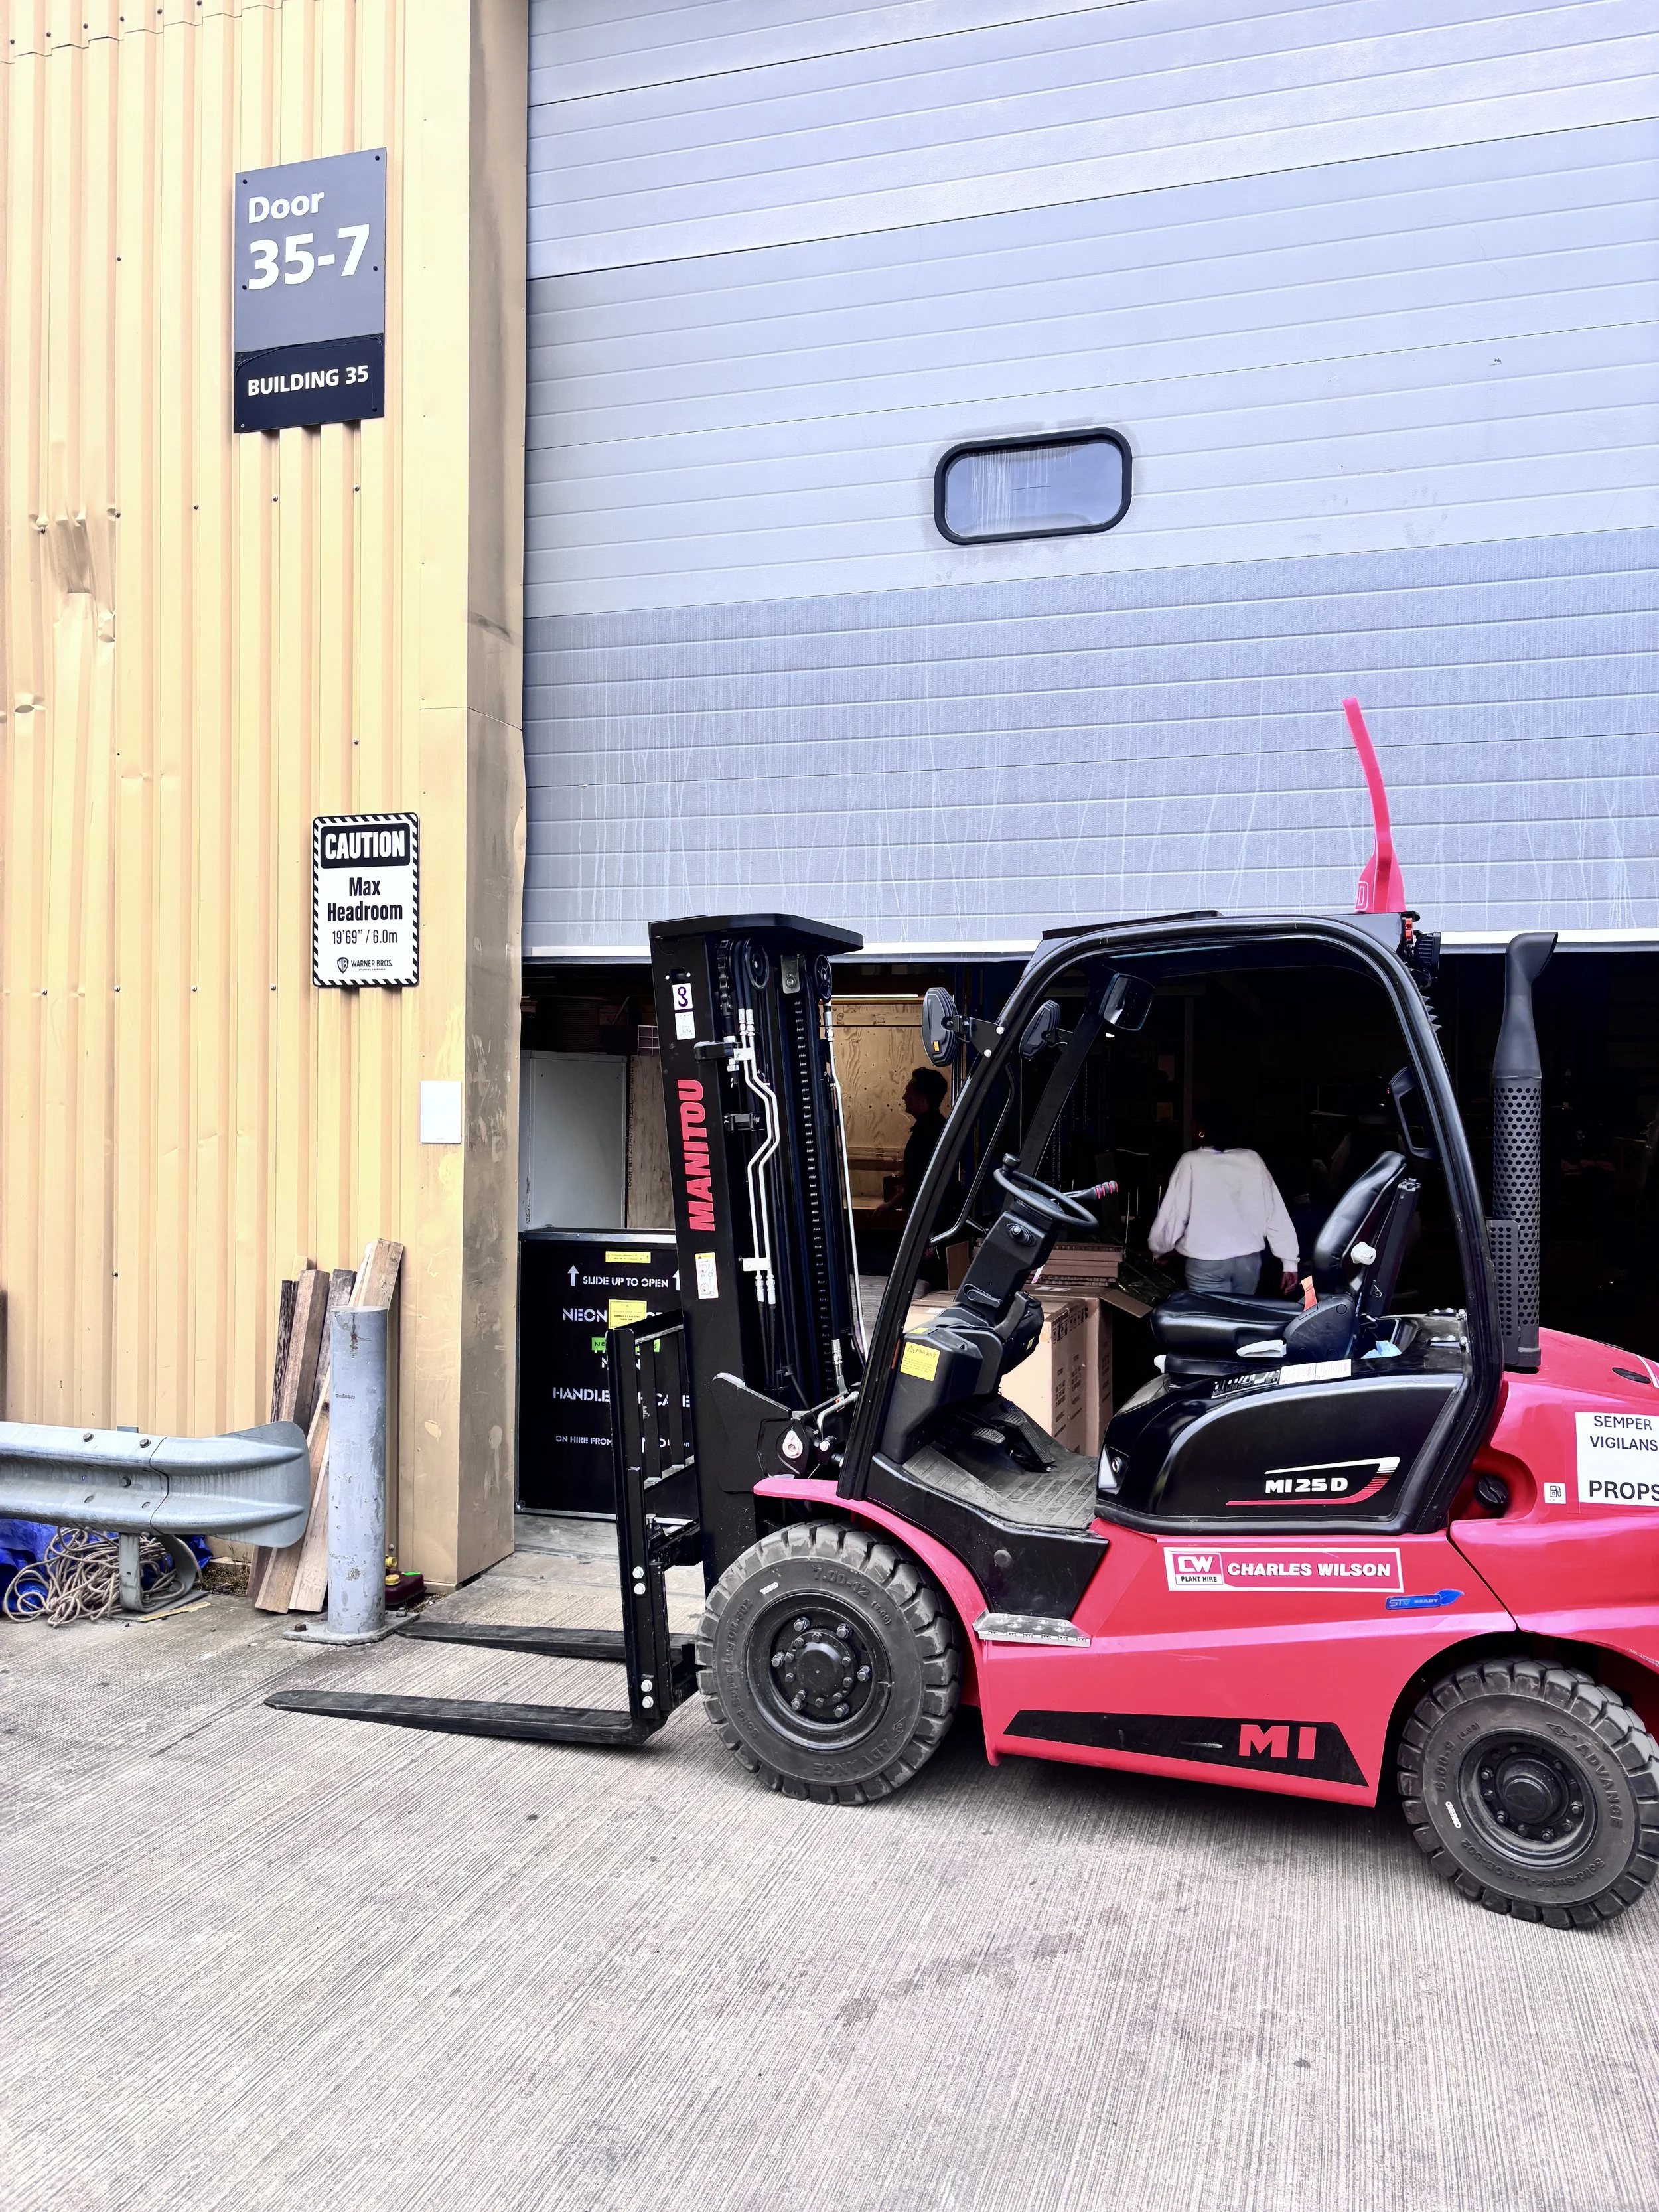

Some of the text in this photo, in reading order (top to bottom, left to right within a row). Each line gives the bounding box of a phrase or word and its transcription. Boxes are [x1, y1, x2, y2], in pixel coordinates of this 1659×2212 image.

[248, 192, 325, 224] Door
[248, 224, 370, 290] 35-7
[248, 364, 369, 396] BUILDING 35
[325, 830, 405, 860] CAUTION
[349, 877, 381, 897] Max
[327, 900, 403, 922] Headroom
[373, 929, 397, 944] 6.0m
[350, 959, 375, 968] WARNER
[376, 959, 394, 968] BROS.
[677, 1079, 715, 1232] MANITOU
[583, 1276, 669, 1288] SLIDE UP TO OPEN
[563, 1308, 607, 1323] NEON
[1593, 1415, 1652, 1430] SEMPER
[570, 1436, 589, 1444] HIRE
[1589, 1436, 1658, 1451] VIGILANS
[1589, 1480, 1659, 1501] PROPS
[1177, 1556, 1213, 1572] CW
[1227, 1562, 1391, 1577] CHARLES WILSON
[812, 1565, 870, 1599] 7.00-12
[1238, 1724, 1317, 1760] MI
[1575, 1743, 1623, 1829] ADVANCE
